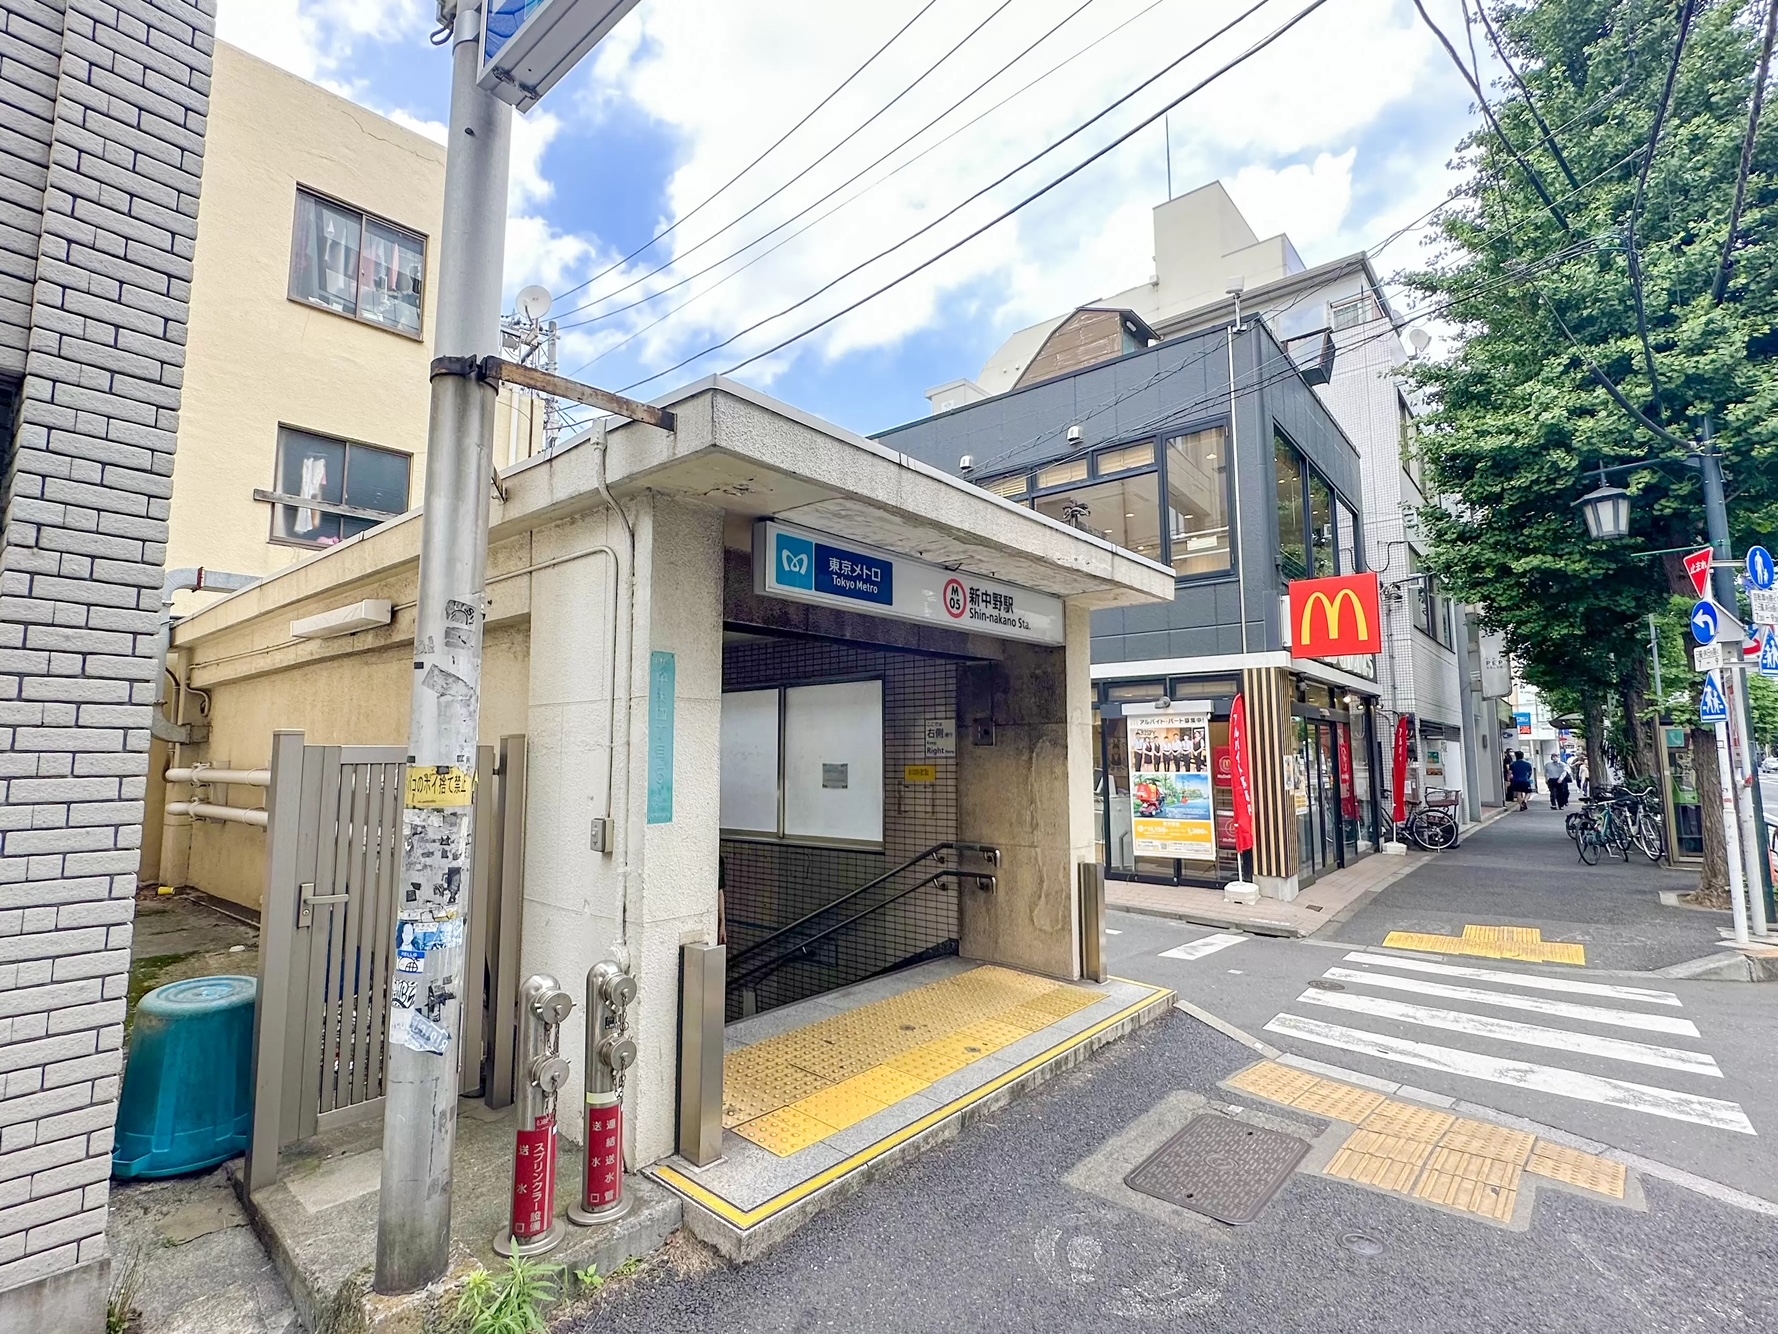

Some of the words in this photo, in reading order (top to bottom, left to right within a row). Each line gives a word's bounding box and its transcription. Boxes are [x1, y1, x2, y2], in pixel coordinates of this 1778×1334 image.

[829, 557, 881, 582] 東京メトロ
[1690, 560, 1707, 574] 止まれ
[832, 574, 855, 590] Tokyo
[856, 580, 878, 594] Metro
[951, 585, 959, 597] M
[949, 597, 961, 610] 05
[969, 586, 1014, 614] 新中野駅
[969, 607, 1017, 627] Shin-nakano
[1018, 618, 1031, 630] Sta.
[927, 728, 944, 739] 右側
[927, 747, 945, 755] Right
[604, 1118, 616, 1202] 連結送水管
[529, 1142, 546, 1232] スプリンクラー設備
